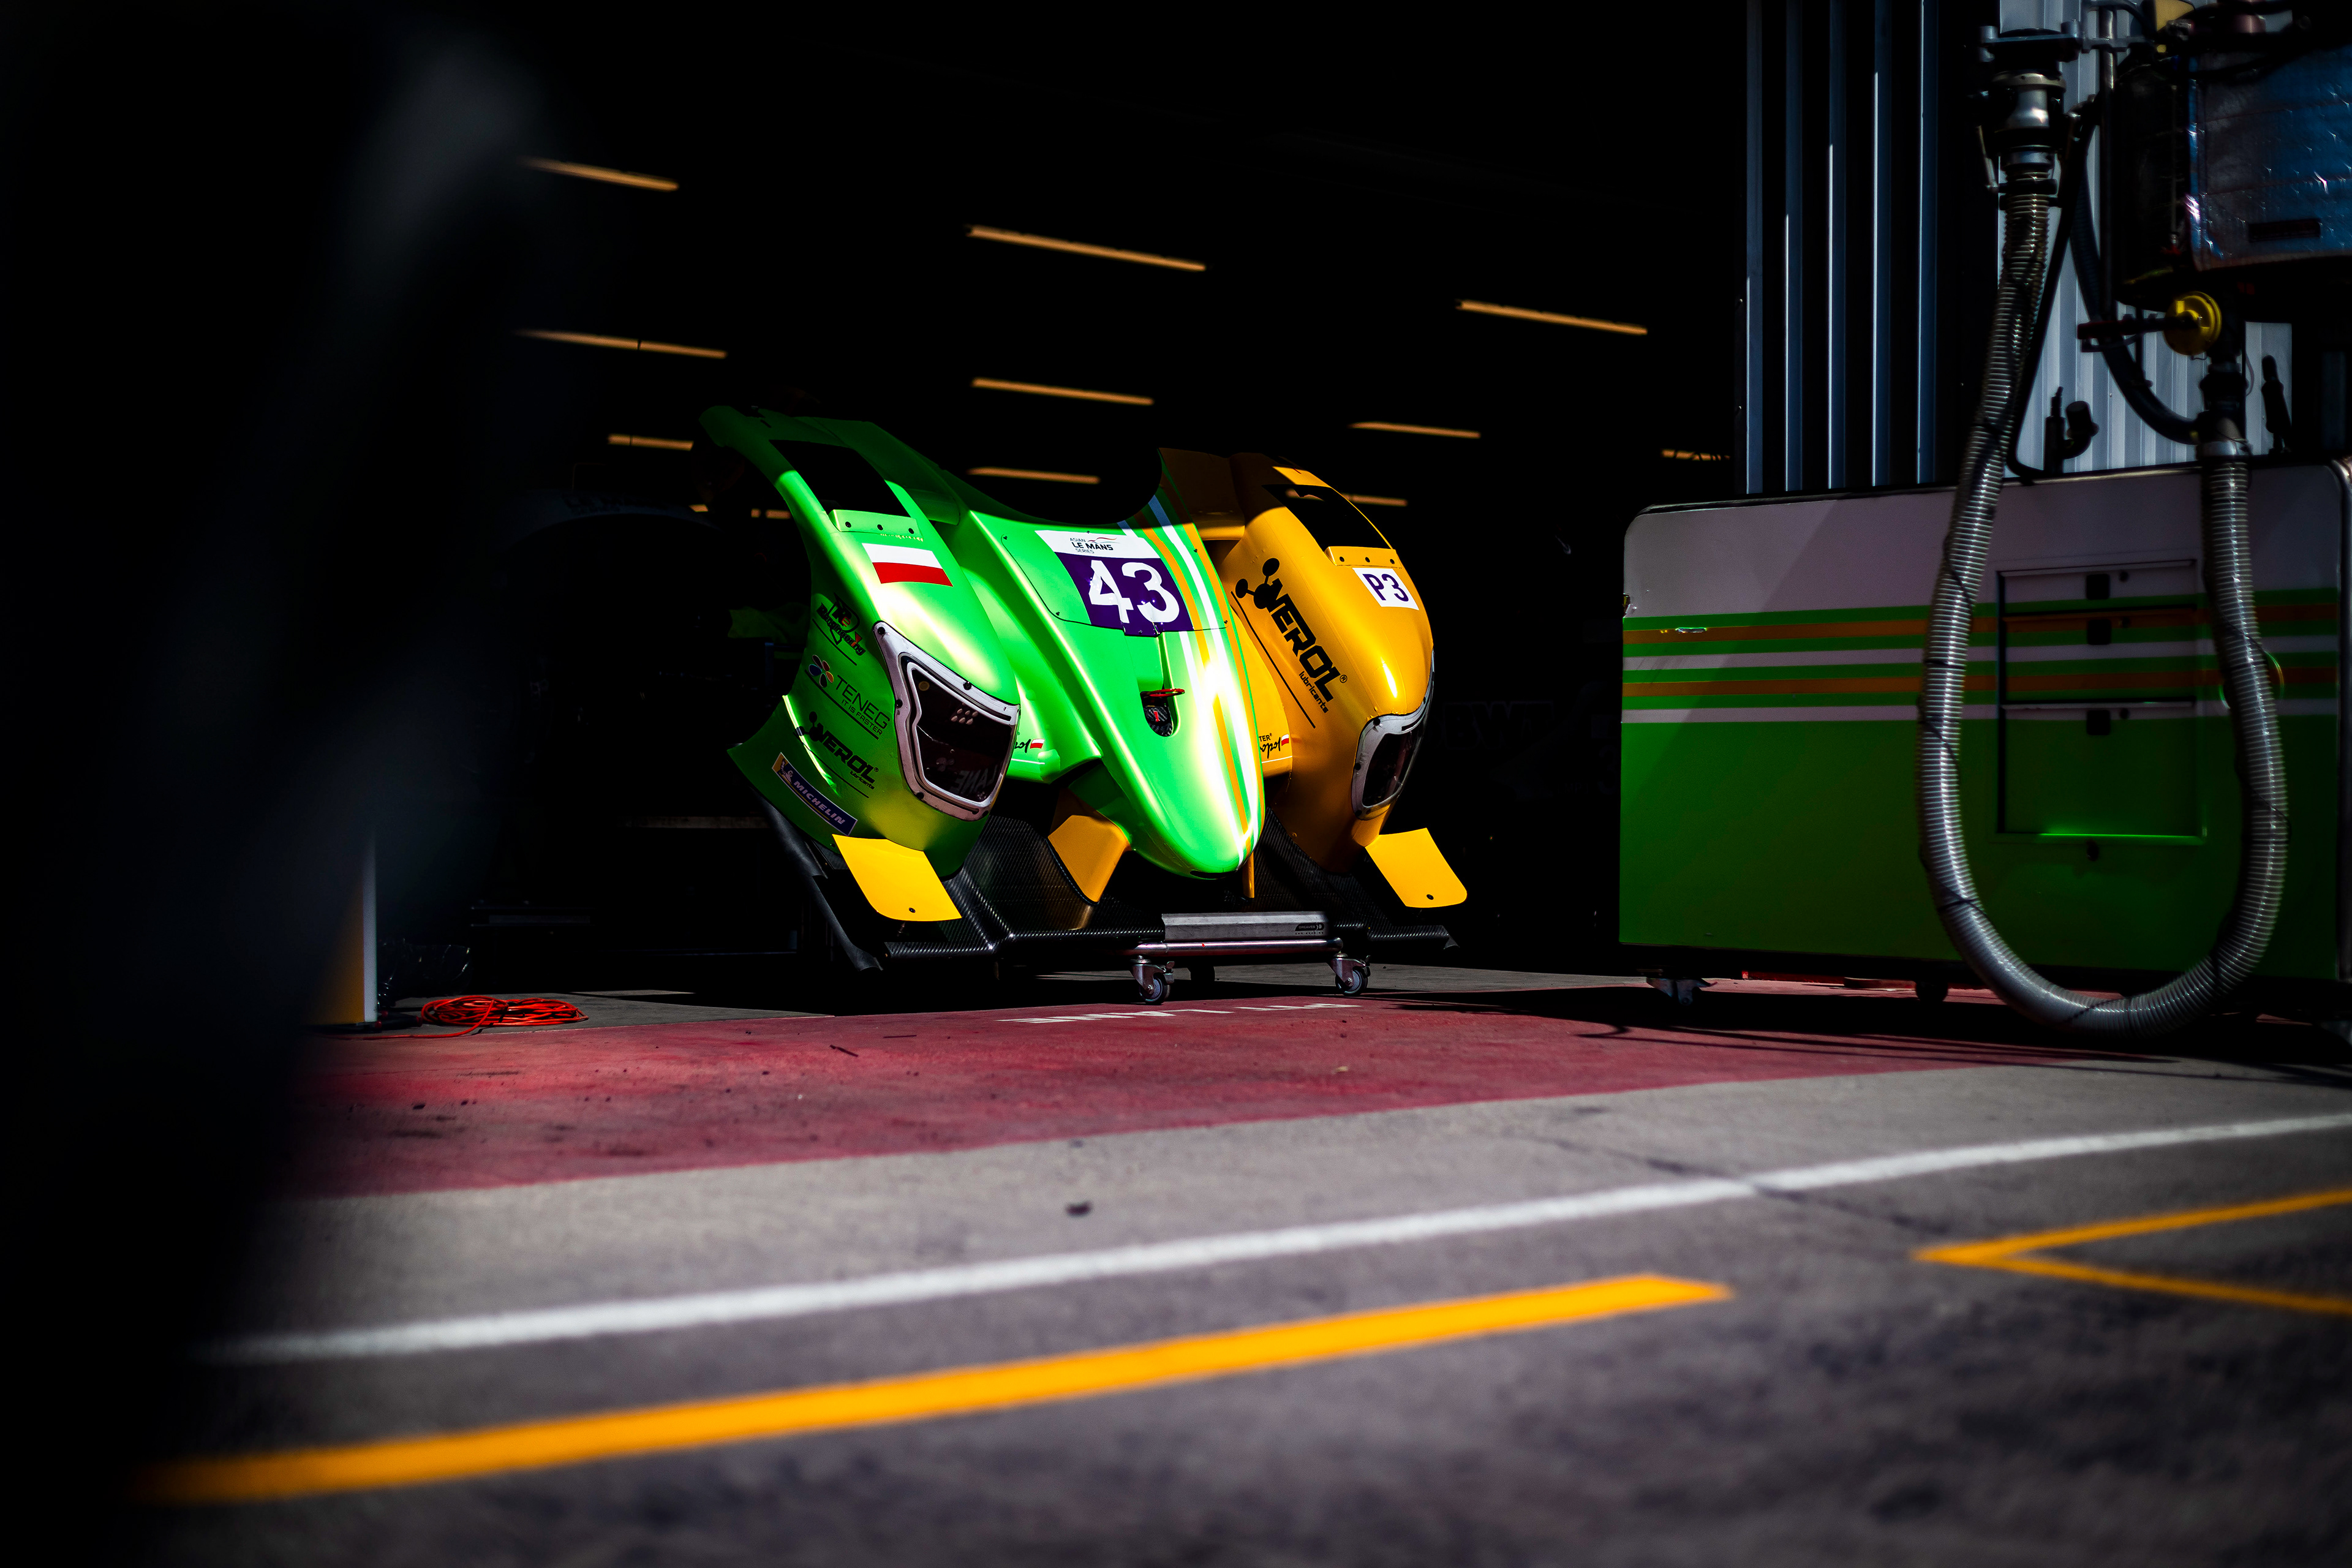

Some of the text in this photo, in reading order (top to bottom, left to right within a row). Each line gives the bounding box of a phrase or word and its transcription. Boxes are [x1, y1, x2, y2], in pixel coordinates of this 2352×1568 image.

[1088, 559, 1180, 624] 43
[1362, 573, 1409, 602] P3
[835, 674, 891, 729] TENEG
[1298, 671, 1329, 714] lubricants
[856, 711, 883, 736] FASTER
[1259, 736, 1281, 760] opol
[793, 780, 846, 825] MICHELIN
